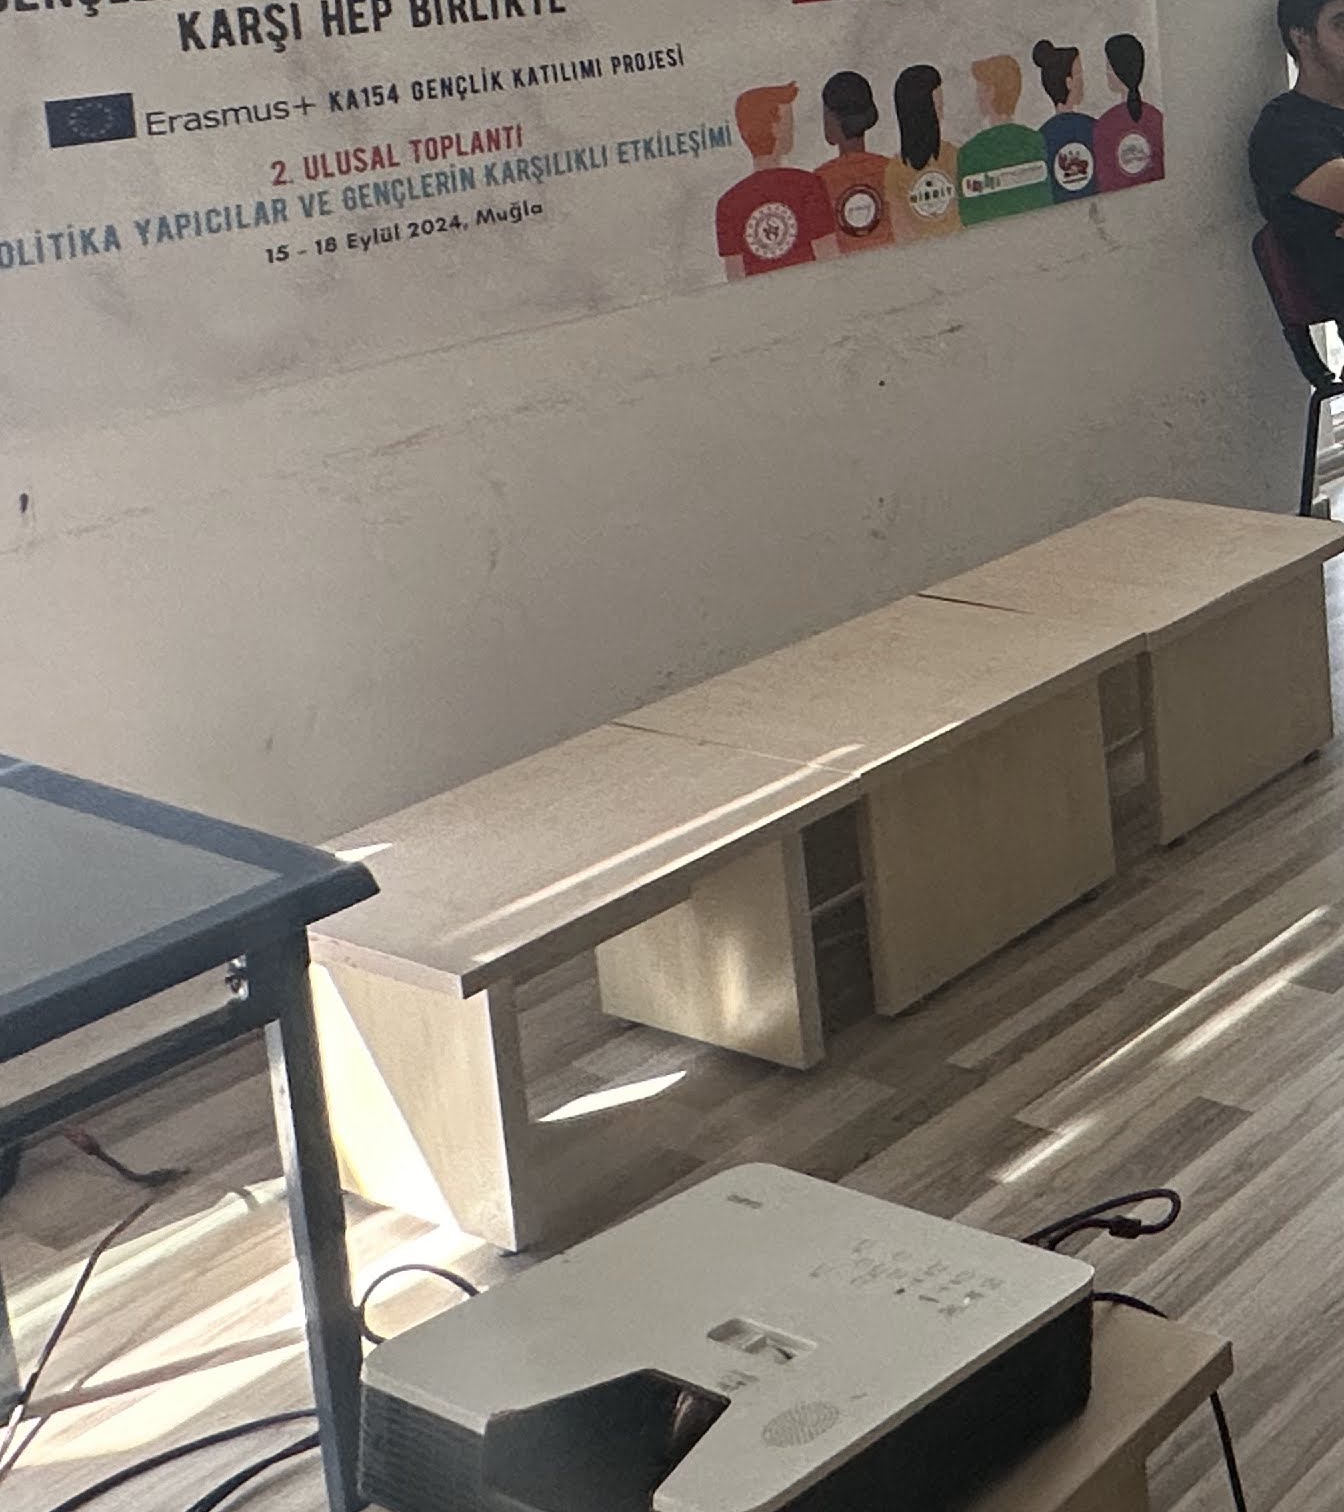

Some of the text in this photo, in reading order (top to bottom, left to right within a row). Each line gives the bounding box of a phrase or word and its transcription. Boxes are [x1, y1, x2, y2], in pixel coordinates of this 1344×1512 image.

[176, 1, 303, 54] KARŞI
[145, 42, 685, 137] Erasmus+ KA154 GENÇLİK KATILIMI PROJESİ
[133, 197, 289, 247] YAPICILAR
[297, 189, 335, 219] VE
[341, 163, 476, 212] GENÇLERİN
[484, 144, 608, 187] KARŞILIKLI
[617, 119, 732, 164] ETKİLEŞİMİ
[270, 122, 523, 187] 2. ULUSAL TOPLANTI
[265, 244, 290, 264] 15
[346, 222, 401, 253] Eylül
[406, 214, 469, 239] 2024,
[475, 197, 544, 227] Muğla
